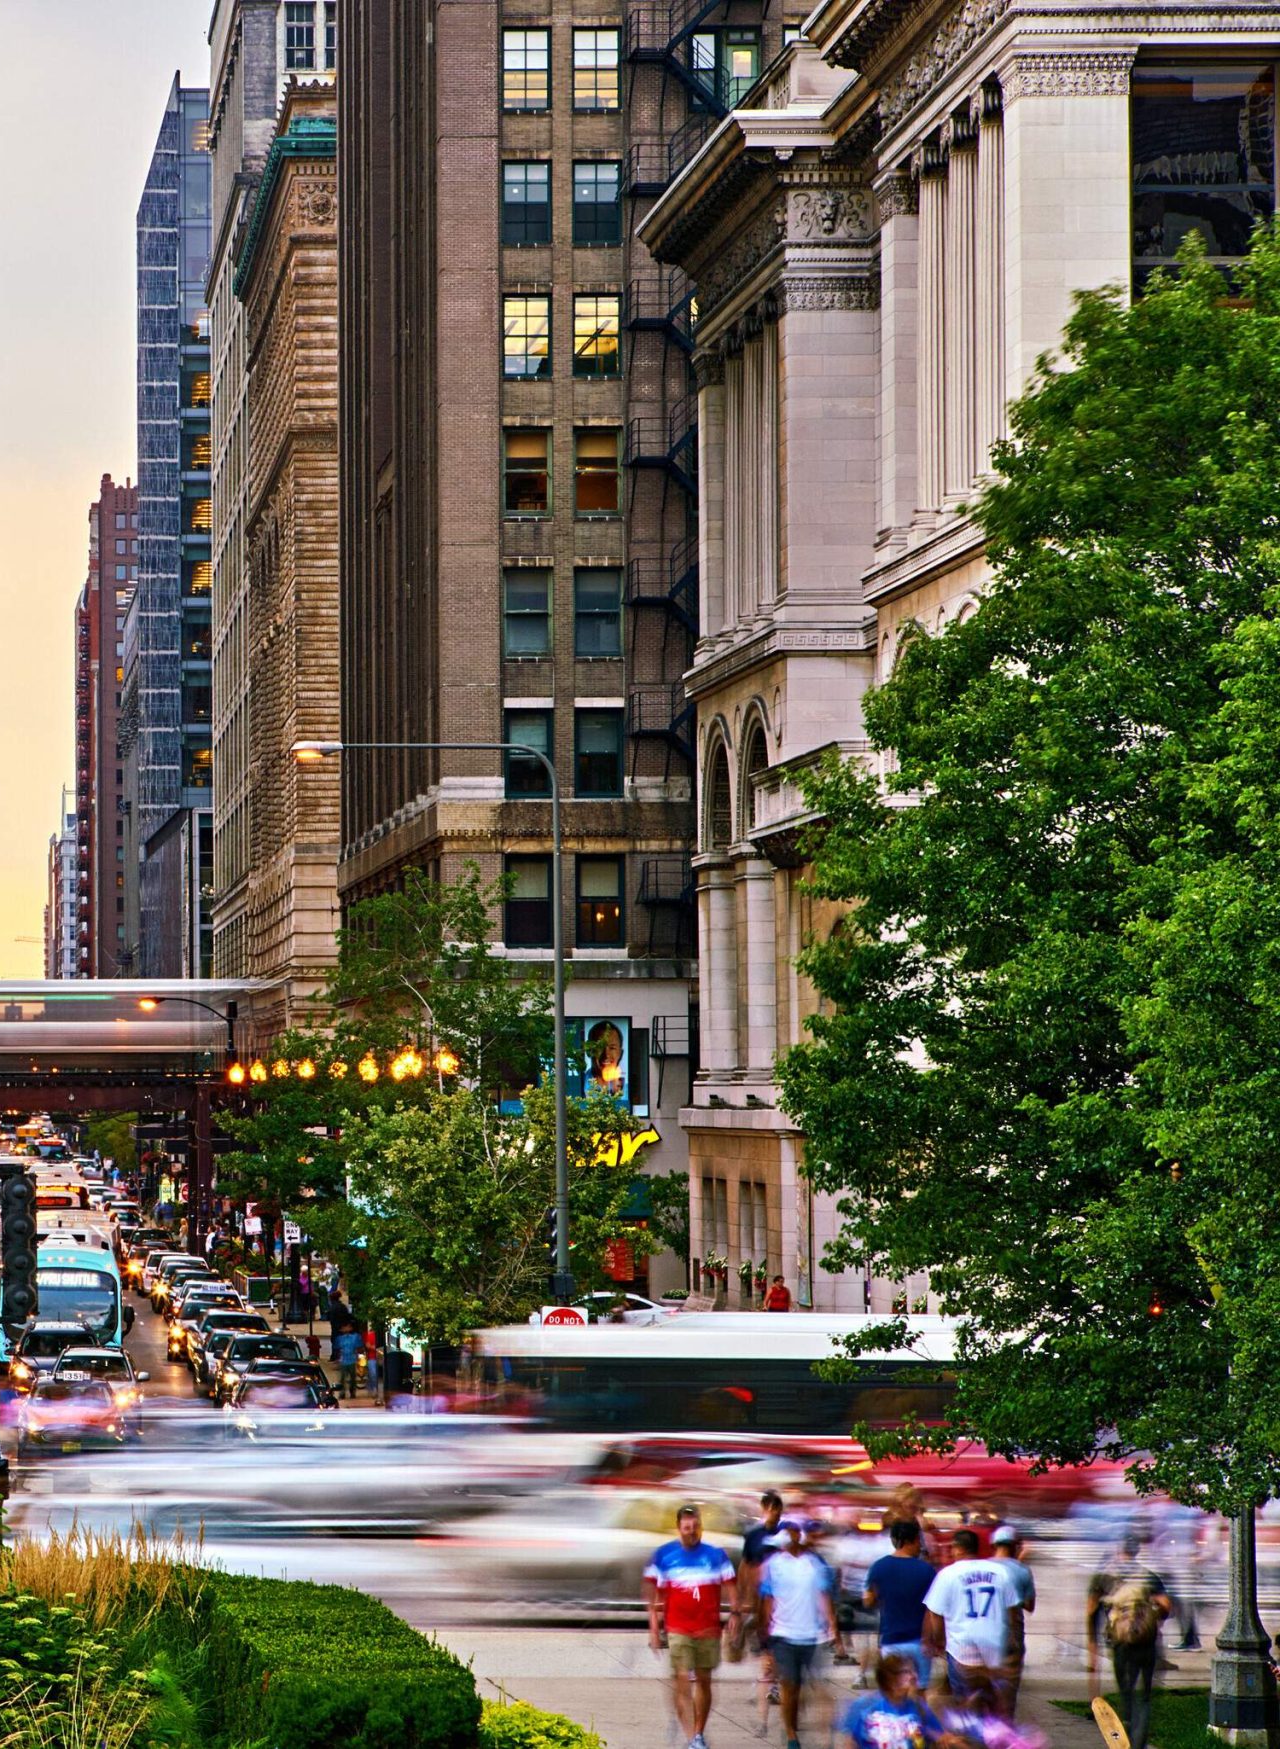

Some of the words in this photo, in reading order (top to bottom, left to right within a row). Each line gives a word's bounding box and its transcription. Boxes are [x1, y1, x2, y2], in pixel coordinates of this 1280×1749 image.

[549, 1316, 560, 1324] DO
[563, 1317, 580, 1325] NOT
[692, 1586, 700, 1602] 4
[964, 1586, 996, 1619] 17
